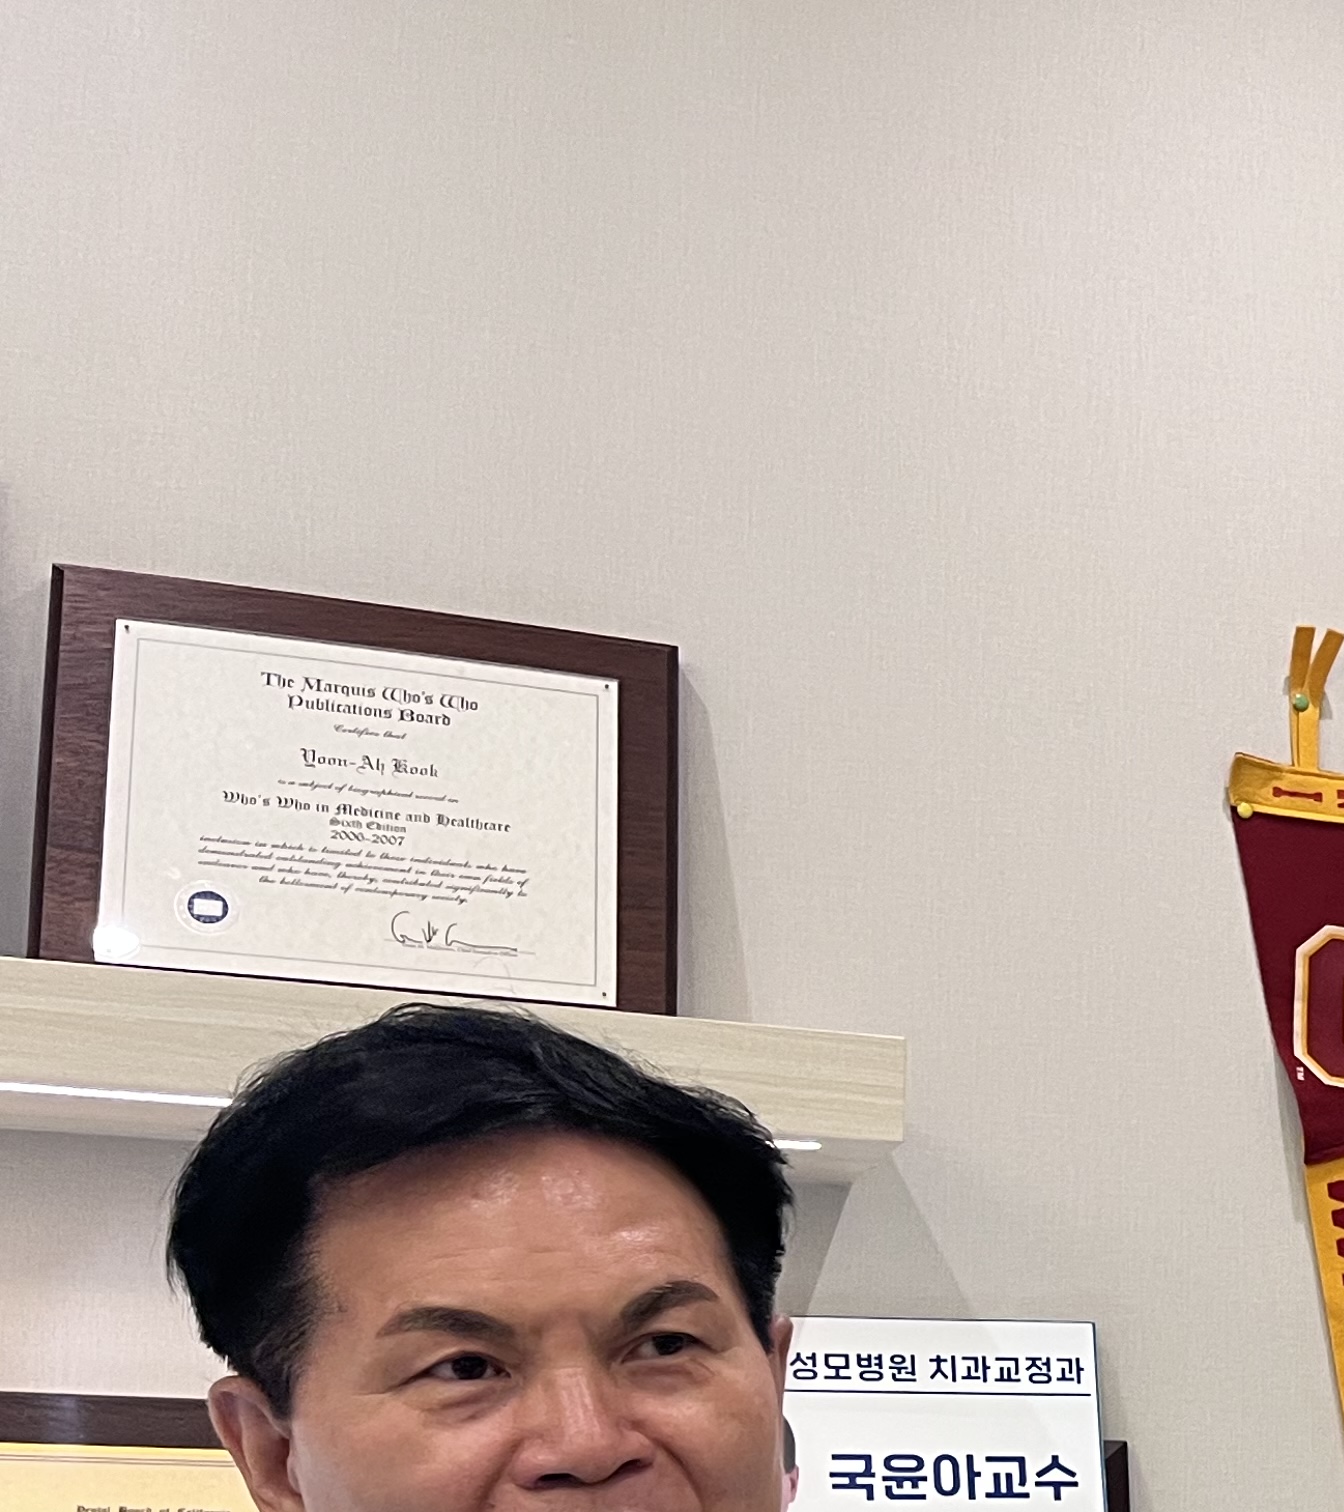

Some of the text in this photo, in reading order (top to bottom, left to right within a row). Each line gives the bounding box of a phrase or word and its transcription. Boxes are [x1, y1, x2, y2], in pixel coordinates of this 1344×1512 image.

[261, 672, 478, 713] The Marquis Who's Who
[288, 694, 451, 726] Publications Board
[300, 748, 438, 778] Yoon-Ah Kook
[223, 790, 511, 833] Who's Who in Medicine and Healthcare
[366, 821, 406, 833] Edition
[789, 1352, 1085, 1385] 성모병원 치과교정과
[829, 1454, 1079, 1501] 국윤아교수
